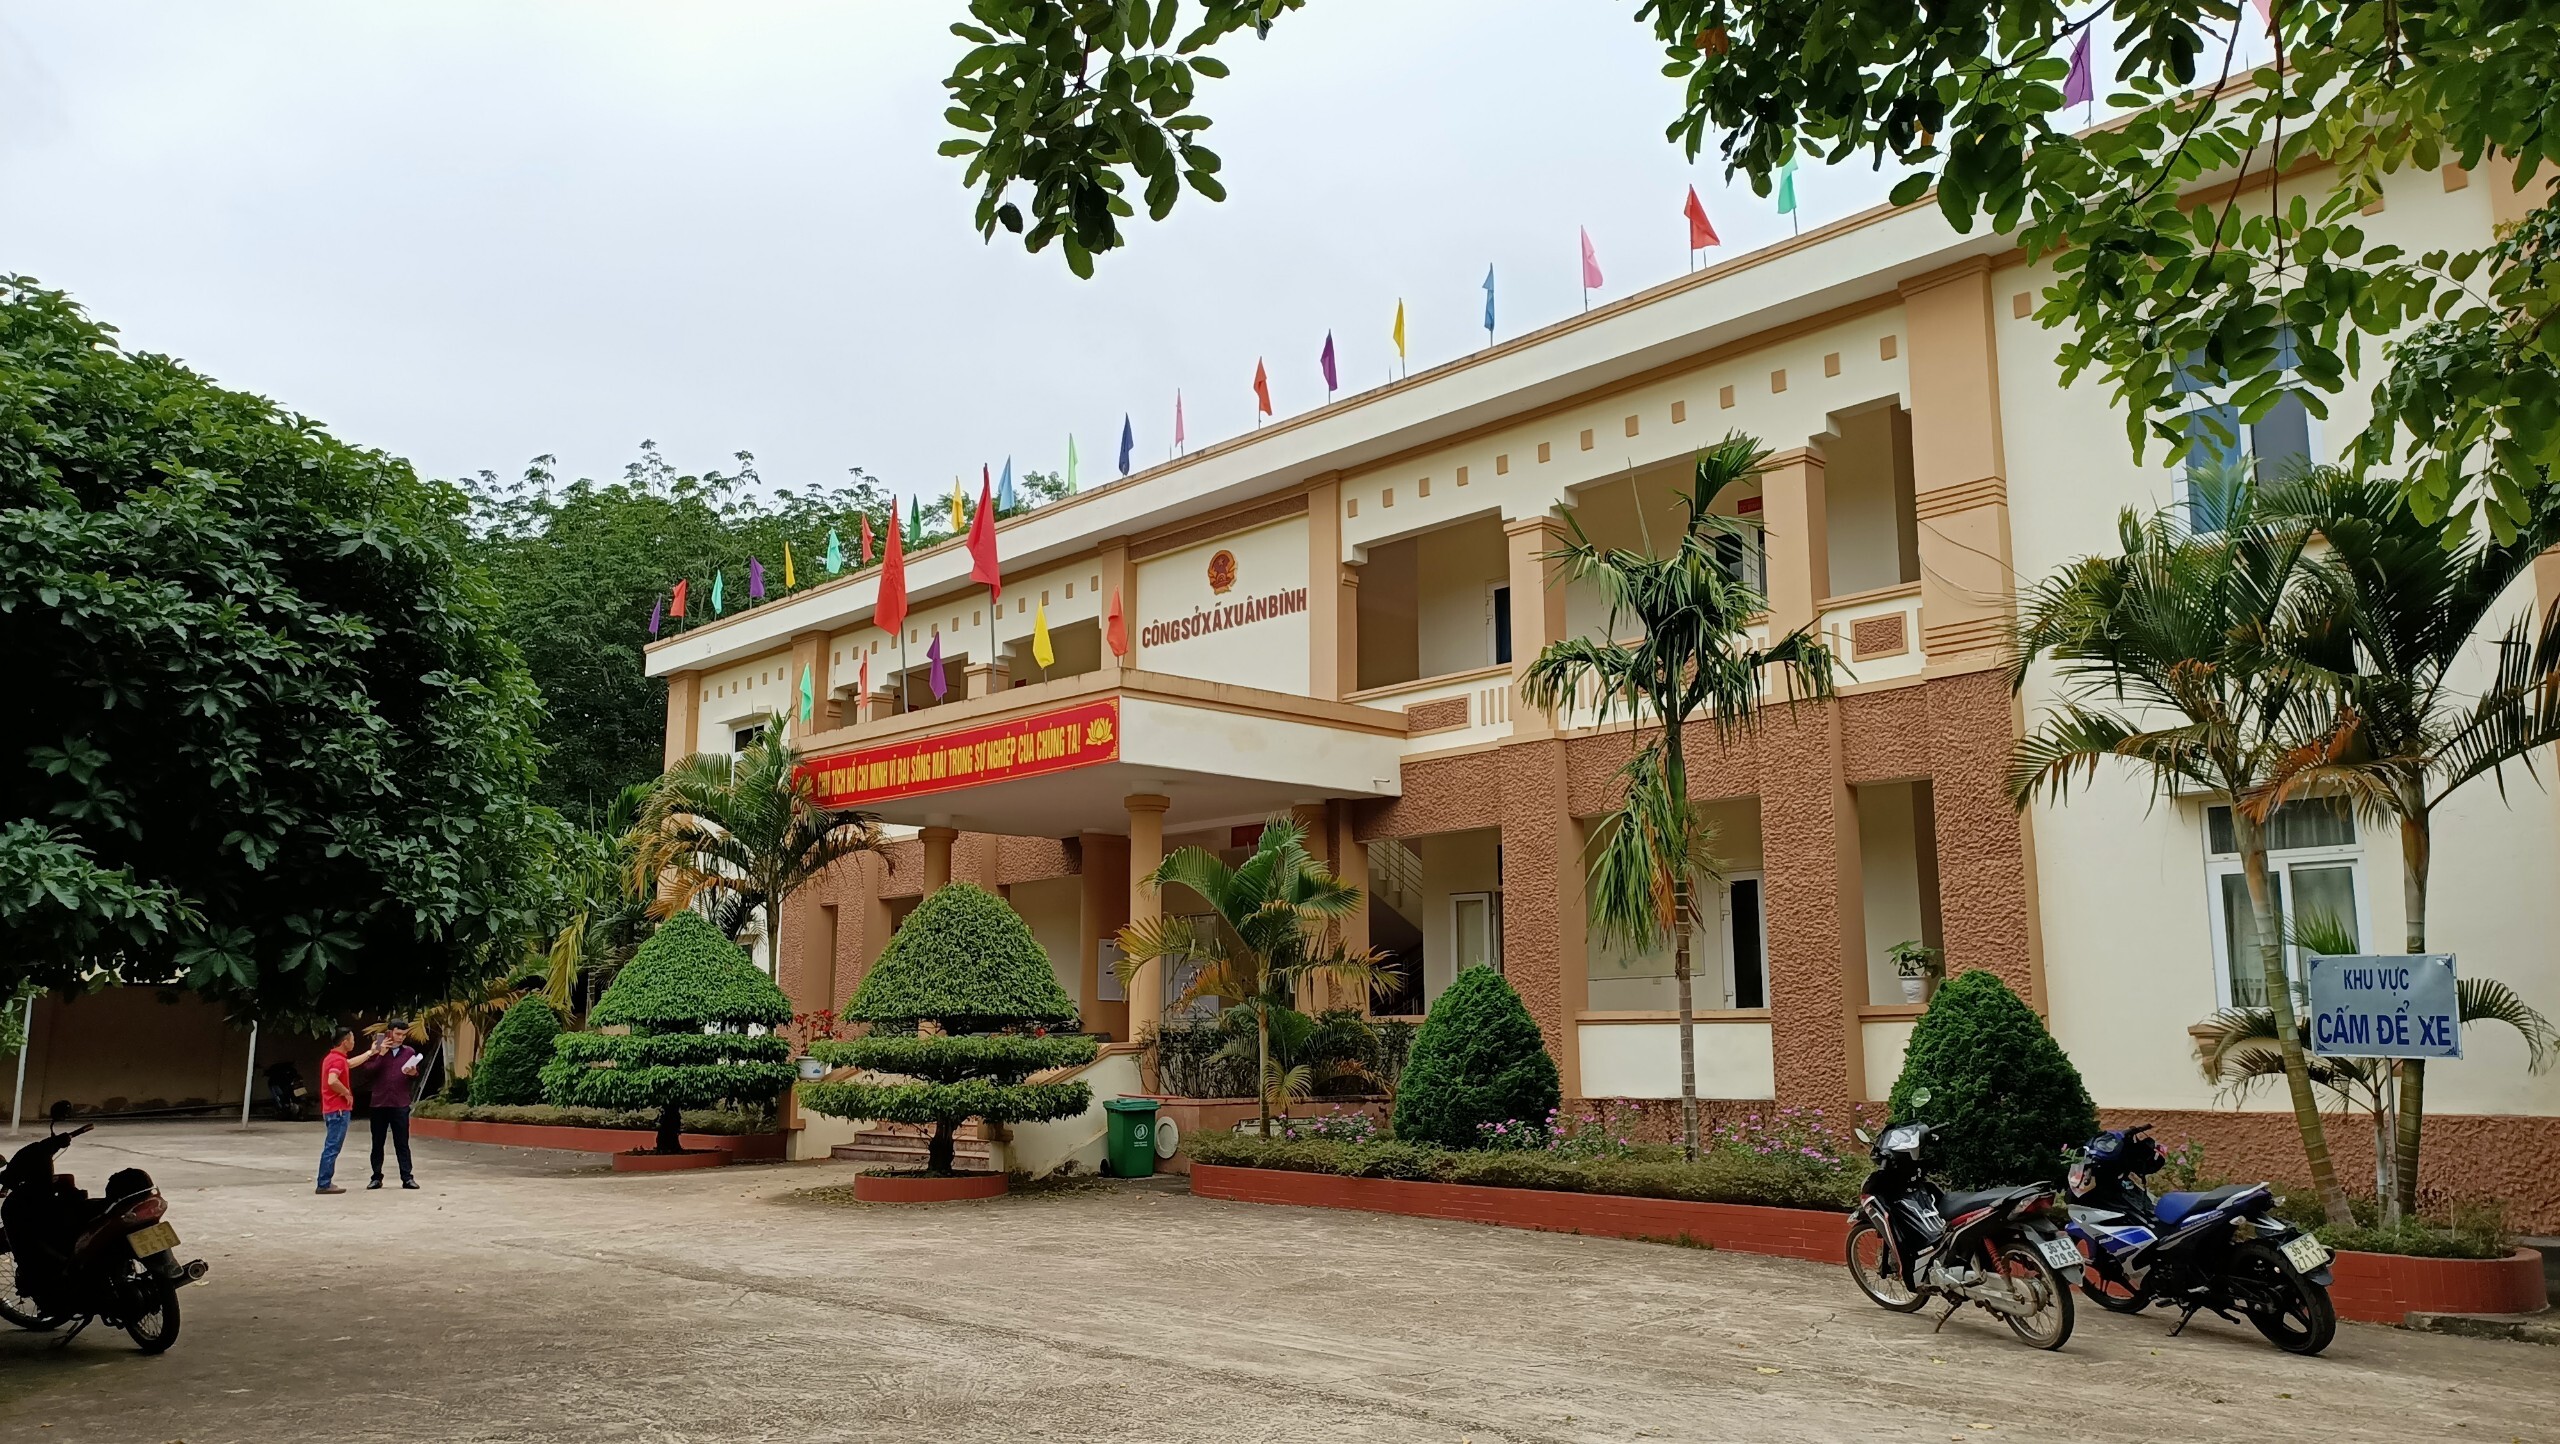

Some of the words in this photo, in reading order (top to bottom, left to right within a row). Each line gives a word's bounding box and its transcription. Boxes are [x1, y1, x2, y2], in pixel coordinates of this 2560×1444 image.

[1142, 618, 1181, 648] CÔNG
[1223, 595, 1267, 630] XUÂN
[1268, 587, 1308, 620] BÌNH
[817, 760, 830, 798] CHỦ
[832, 768, 846, 802] TỊCH
[846, 757, 857, 793] HỒ
[857, 758, 869, 792] CHÍ
[869, 761, 888, 789] MINH
[889, 754, 897, 787] VĨ
[897, 757, 910, 791] ĐẠI
[910, 744, 931, 783] SỐNG
[932, 745, 947, 779] MÃI
[948, 745, 973, 777] TRONG
[975, 739, 987, 778] SỰ
[987, 731, 1016, 773] NGHIỆP
[1017, 721, 1035, 764] CỦA
[1036, 722, 1065, 761] CHÚNG
[1067, 723, 1081, 755] TA!
[2343, 968, 2373, 990] KHU
[2378, 966, 2410, 996] VỰC
[2317, 1005, 2370, 1044] CẤM
[2376, 1000, 2410, 1046] ĐỂ
[2418, 1015, 2452, 1047] XE
[2044, 1239, 2072, 1254] 36-K3
[2287, 1236, 2315, 1257] 36-B5
[2294, 1247, 2327, 1271] 271.12
